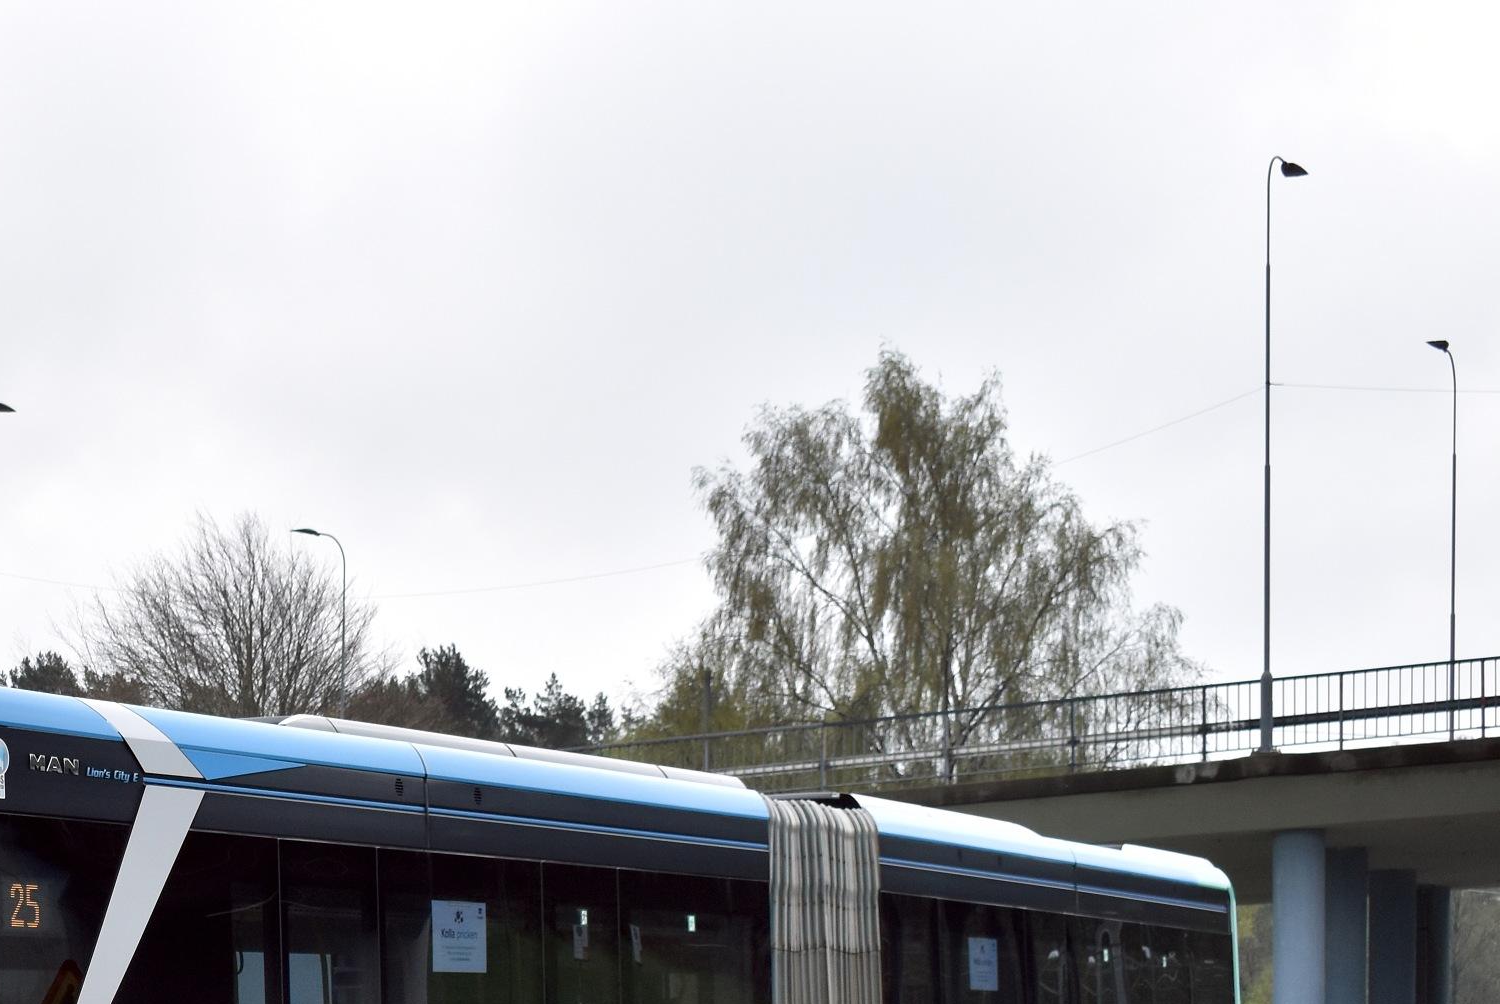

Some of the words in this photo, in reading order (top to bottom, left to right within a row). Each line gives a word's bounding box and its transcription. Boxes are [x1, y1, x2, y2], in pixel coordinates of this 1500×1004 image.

[29, 753, 80, 776] MAN
[86, 766, 111, 779] Lion's
[113, 770, 130, 783] City
[132, 772, 139, 782] E
[10, 883, 40, 928] 25
